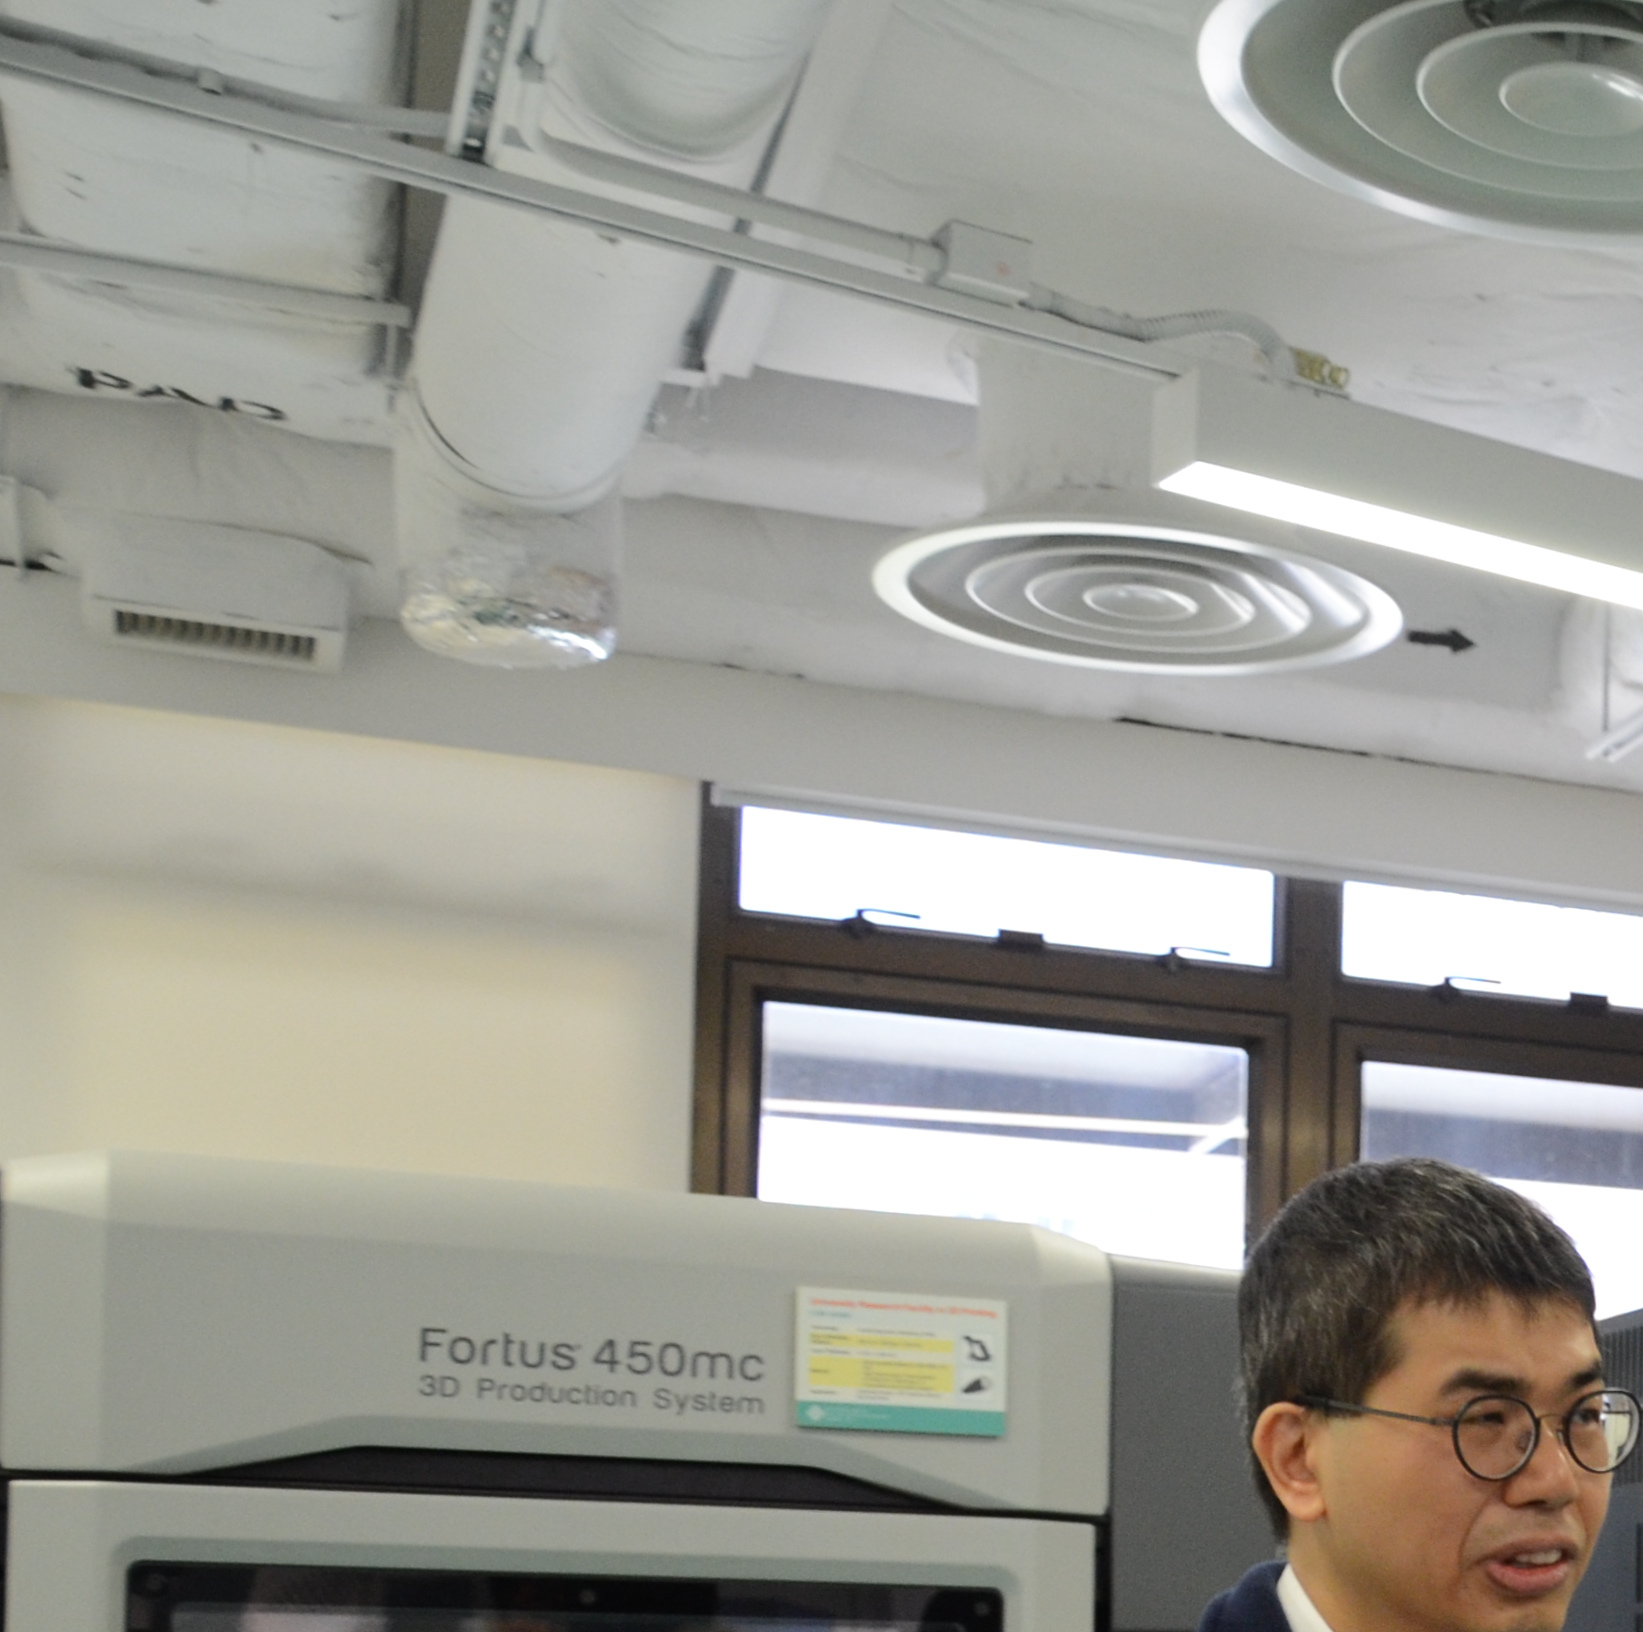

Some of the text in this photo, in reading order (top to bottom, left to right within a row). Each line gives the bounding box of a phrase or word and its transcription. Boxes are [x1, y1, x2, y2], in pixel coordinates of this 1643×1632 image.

[418, 1327, 578, 1371] Fortus
[593, 1338, 765, 1382] 450mc
[418, 1375, 766, 1416] 3D Production System
